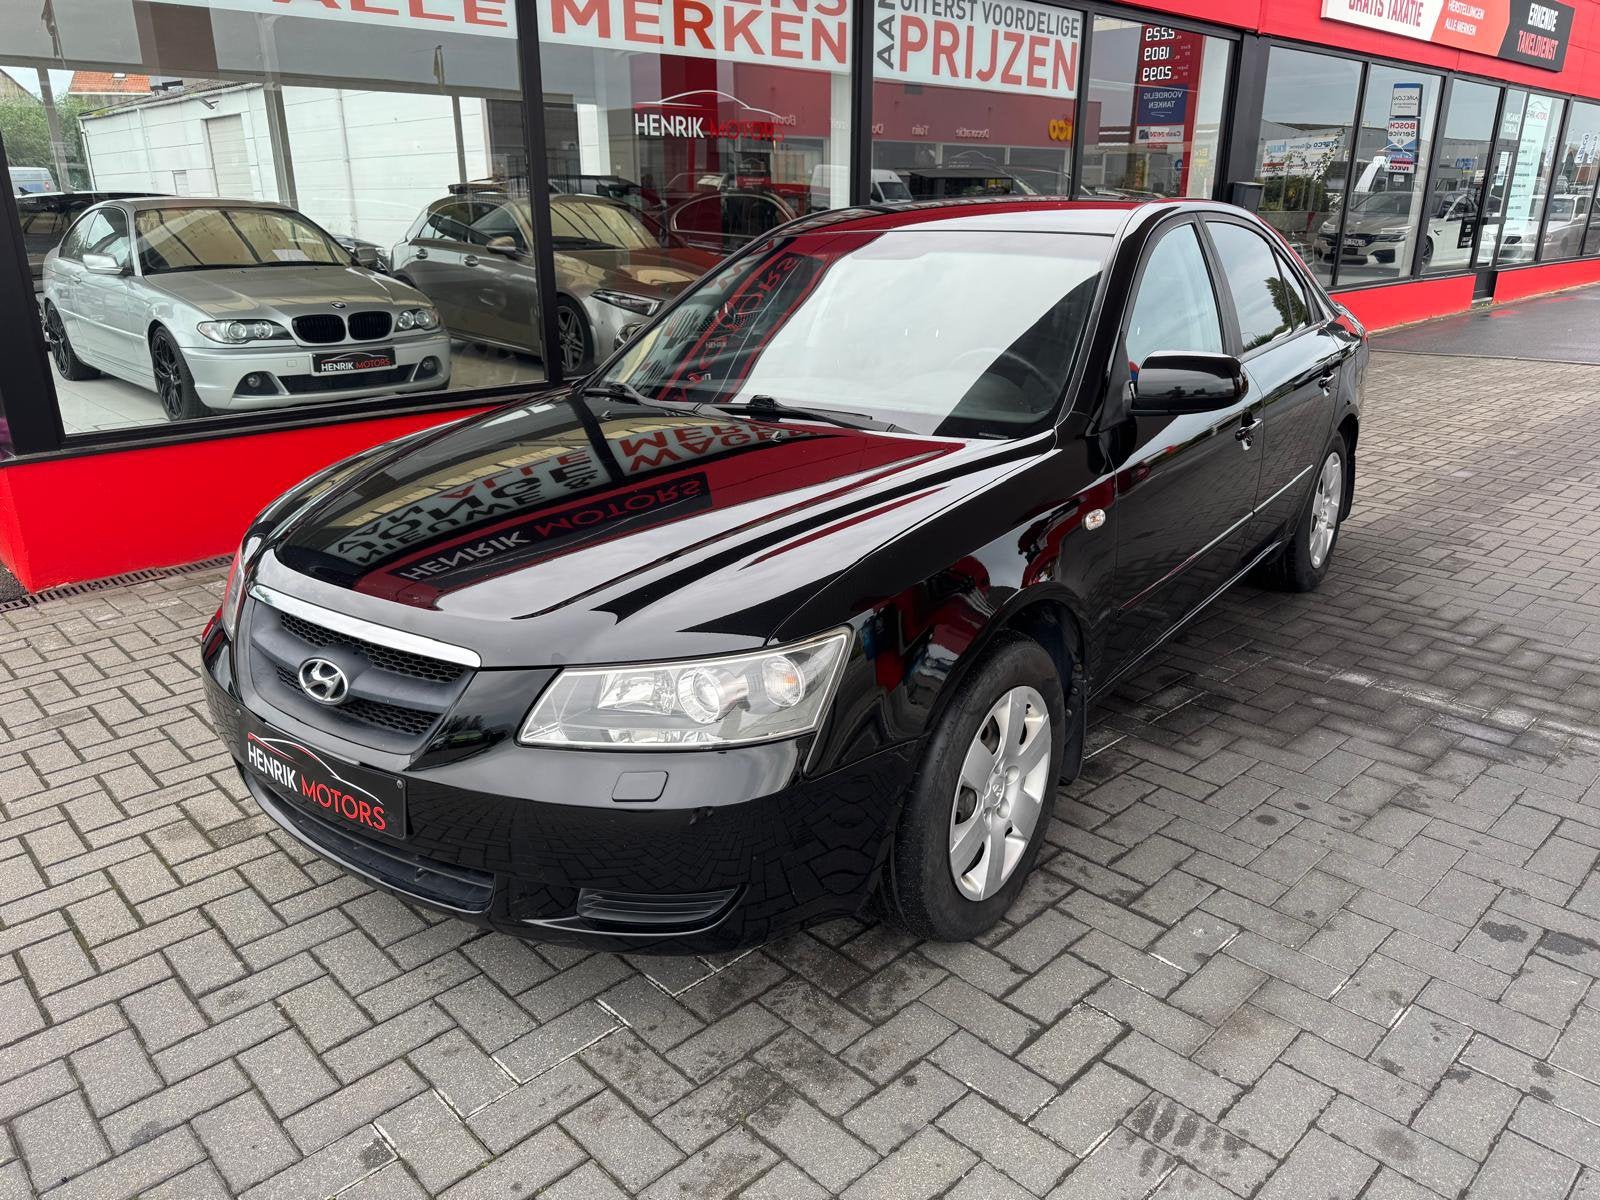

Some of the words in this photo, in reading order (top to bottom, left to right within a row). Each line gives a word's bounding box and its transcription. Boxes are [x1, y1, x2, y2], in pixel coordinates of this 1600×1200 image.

[982, 1, 1080, 38] VOORDELIGE
[1386, 0, 1424, 28] TAXATIE
[1527, 2, 1559, 32] ERKENDE
[550, 0, 847, 64] MERKEN
[1517, 30, 1559, 60] TAKELDIENST
[899, 14, 1078, 92] PRIJZEN
[634, 113, 705, 139] HENRIK
[708, 119, 786, 143] MOTORS
[321, 362, 354, 372] HENRIK
[355, 358, 391, 369] MOTORS
[247, 741, 299, 793] HENRIK
[301, 773, 387, 831] MOTORS
